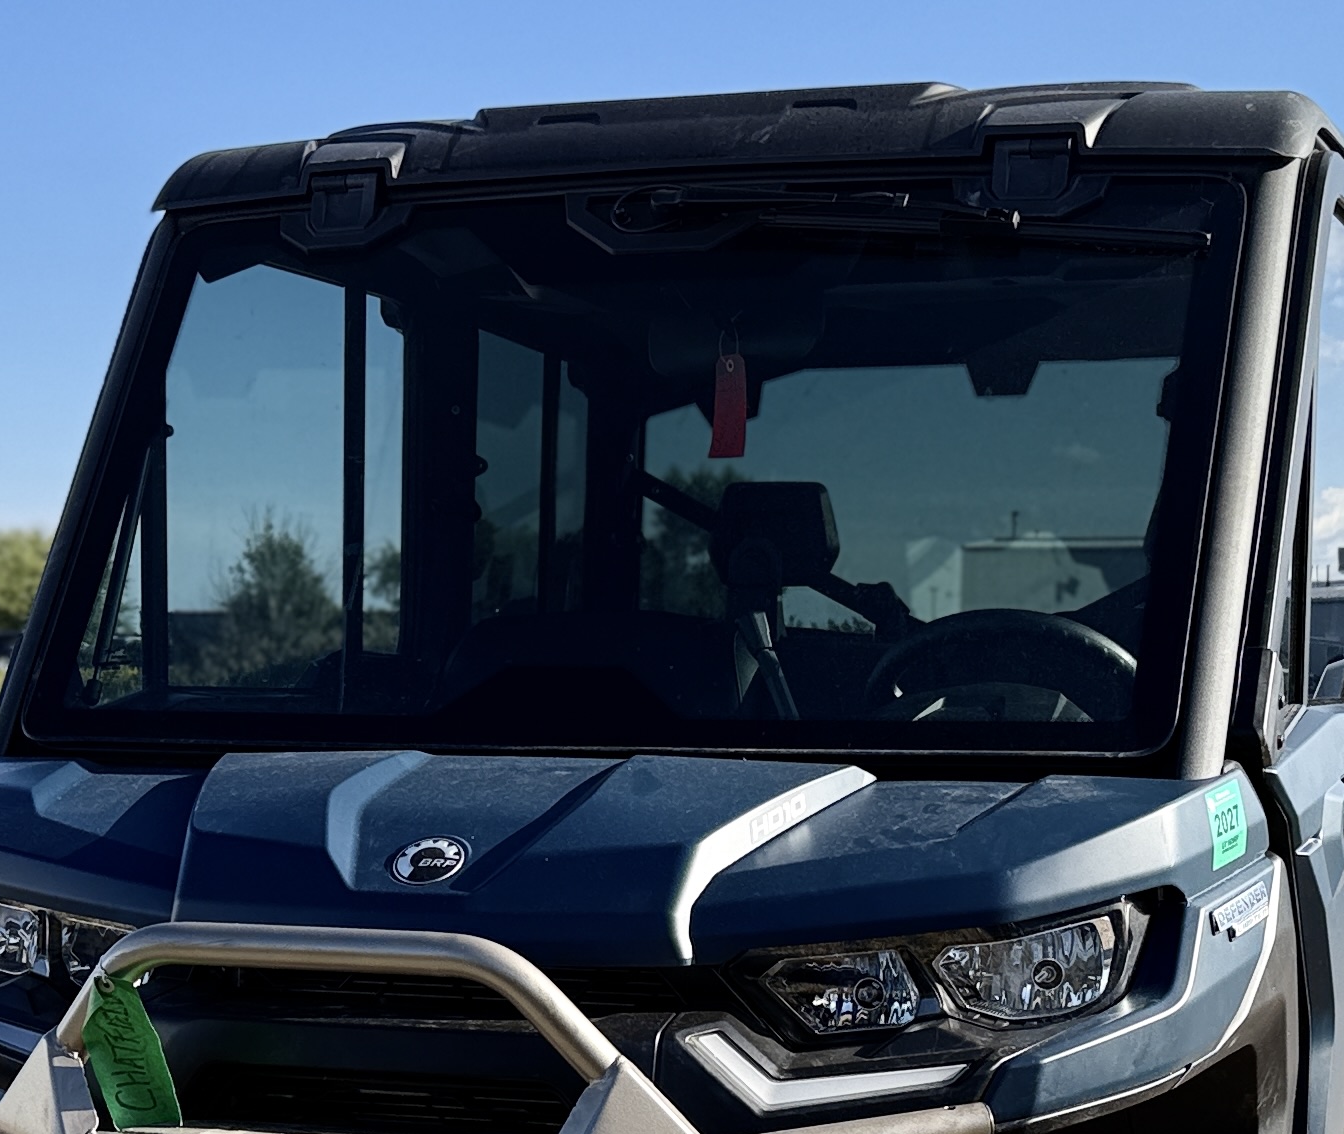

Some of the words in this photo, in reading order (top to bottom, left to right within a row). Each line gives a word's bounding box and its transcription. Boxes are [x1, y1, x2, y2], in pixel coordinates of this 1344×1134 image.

[750, 791, 807, 844] HD10
[1214, 804, 1239, 838] 2027
[418, 858, 458, 868] BRP
[1217, 884, 1267, 928] DEFENDER
